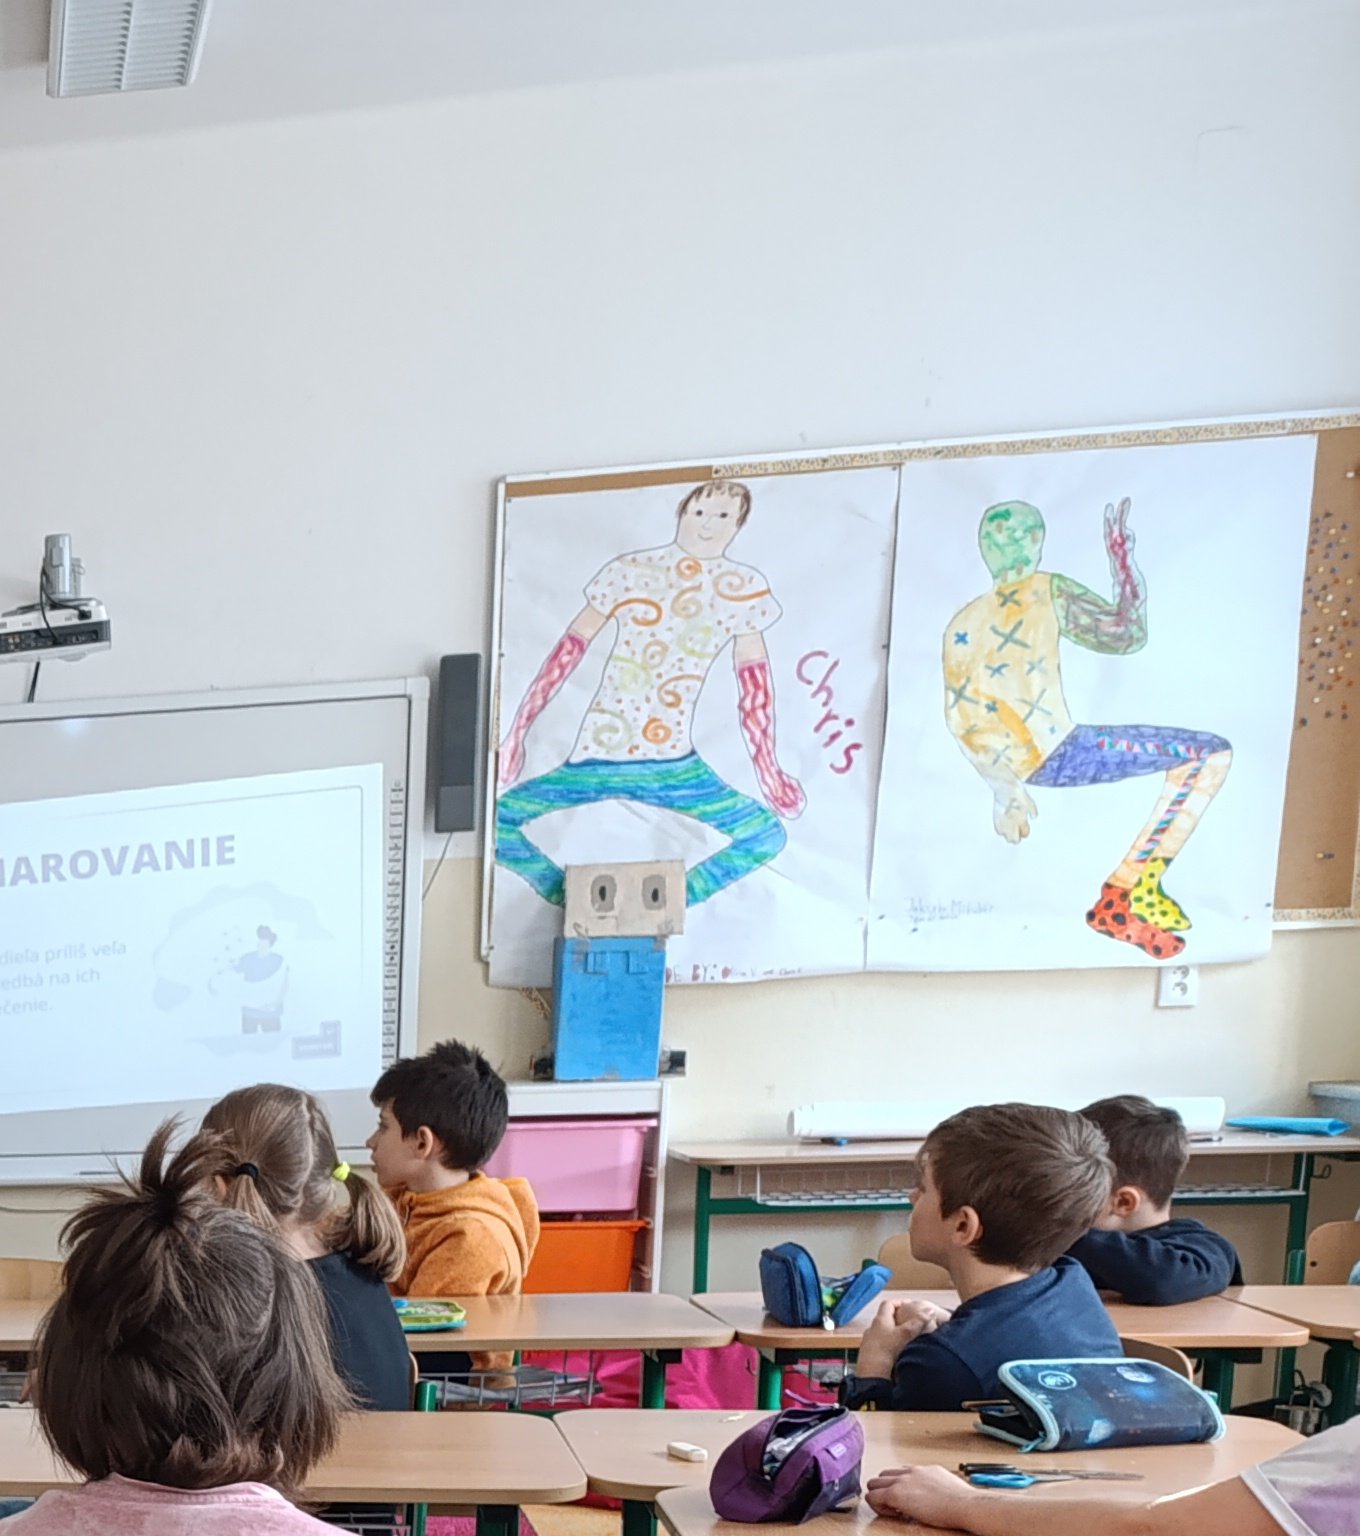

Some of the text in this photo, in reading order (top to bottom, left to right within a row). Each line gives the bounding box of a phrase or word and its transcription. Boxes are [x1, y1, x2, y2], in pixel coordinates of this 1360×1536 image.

[796, 650, 863, 774] Chris
[49, 973, 71, 986] na
[76, 967, 101, 984] ich
